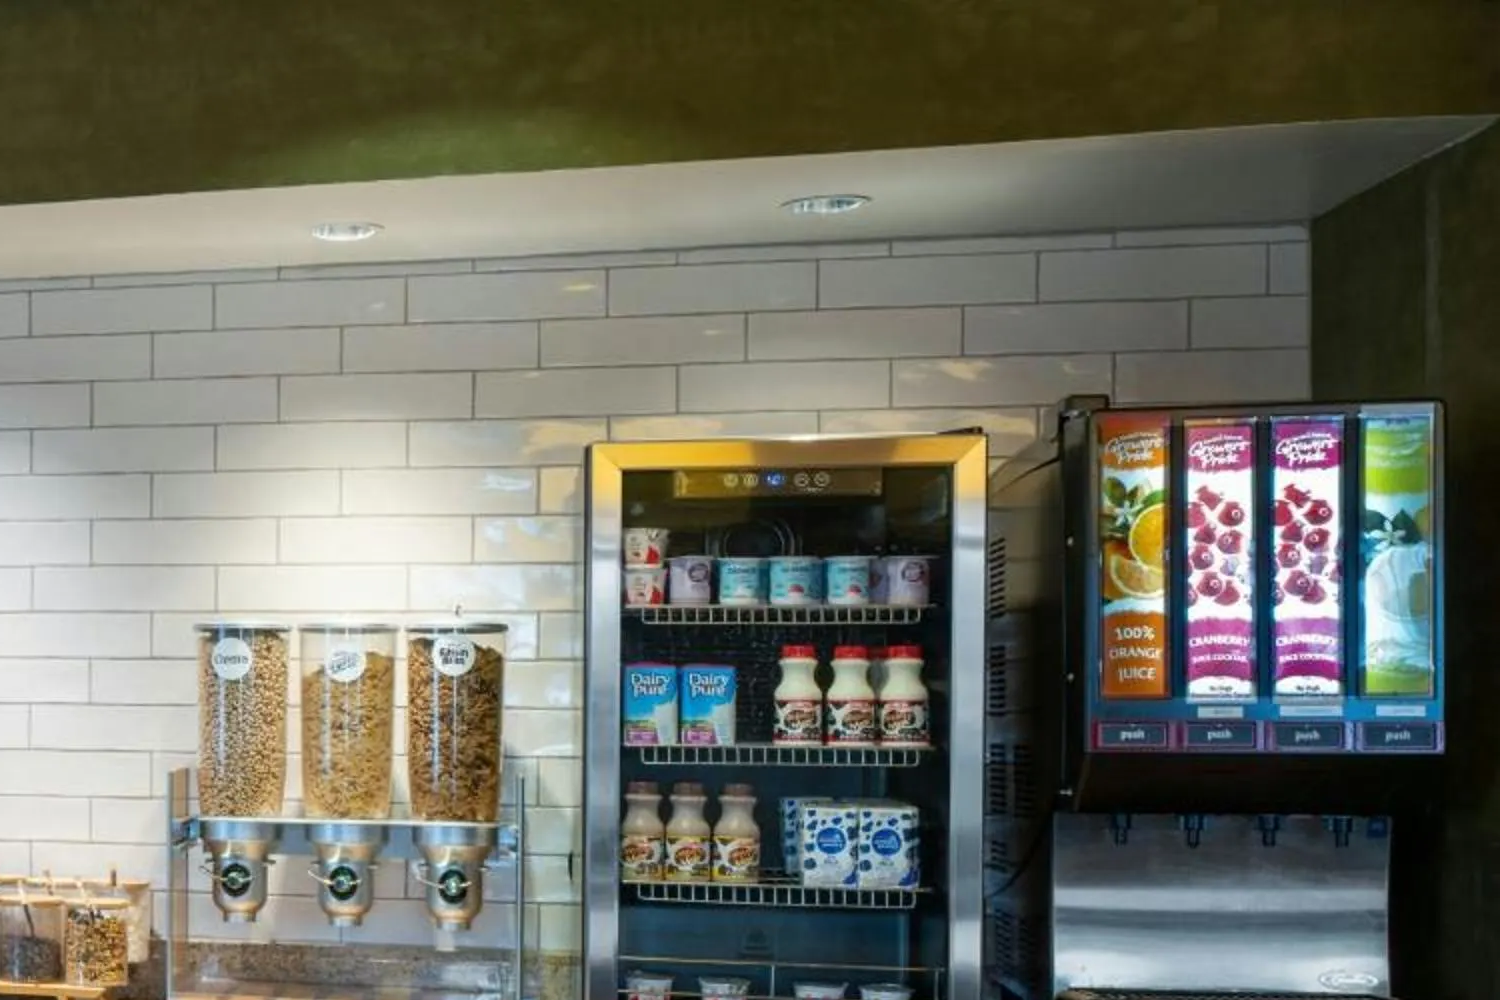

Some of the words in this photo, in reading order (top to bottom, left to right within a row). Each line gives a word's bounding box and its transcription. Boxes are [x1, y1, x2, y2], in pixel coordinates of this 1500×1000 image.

[1114, 626, 1156, 641] 100%
[1275, 633, 1338, 647] CRANBERRY
[1188, 634, 1250, 648] CRANBERRY
[1109, 647, 1163, 661] ORANGE
[630, 672, 671, 687] Dairy
[688, 672, 730, 687] Dairy
[1118, 667, 1157, 682] JUICE
[1120, 729, 1145, 742] push
[1206, 728, 1234, 742] push
[1294, 729, 1321, 743] push
[1384, 729, 1411, 743] push
